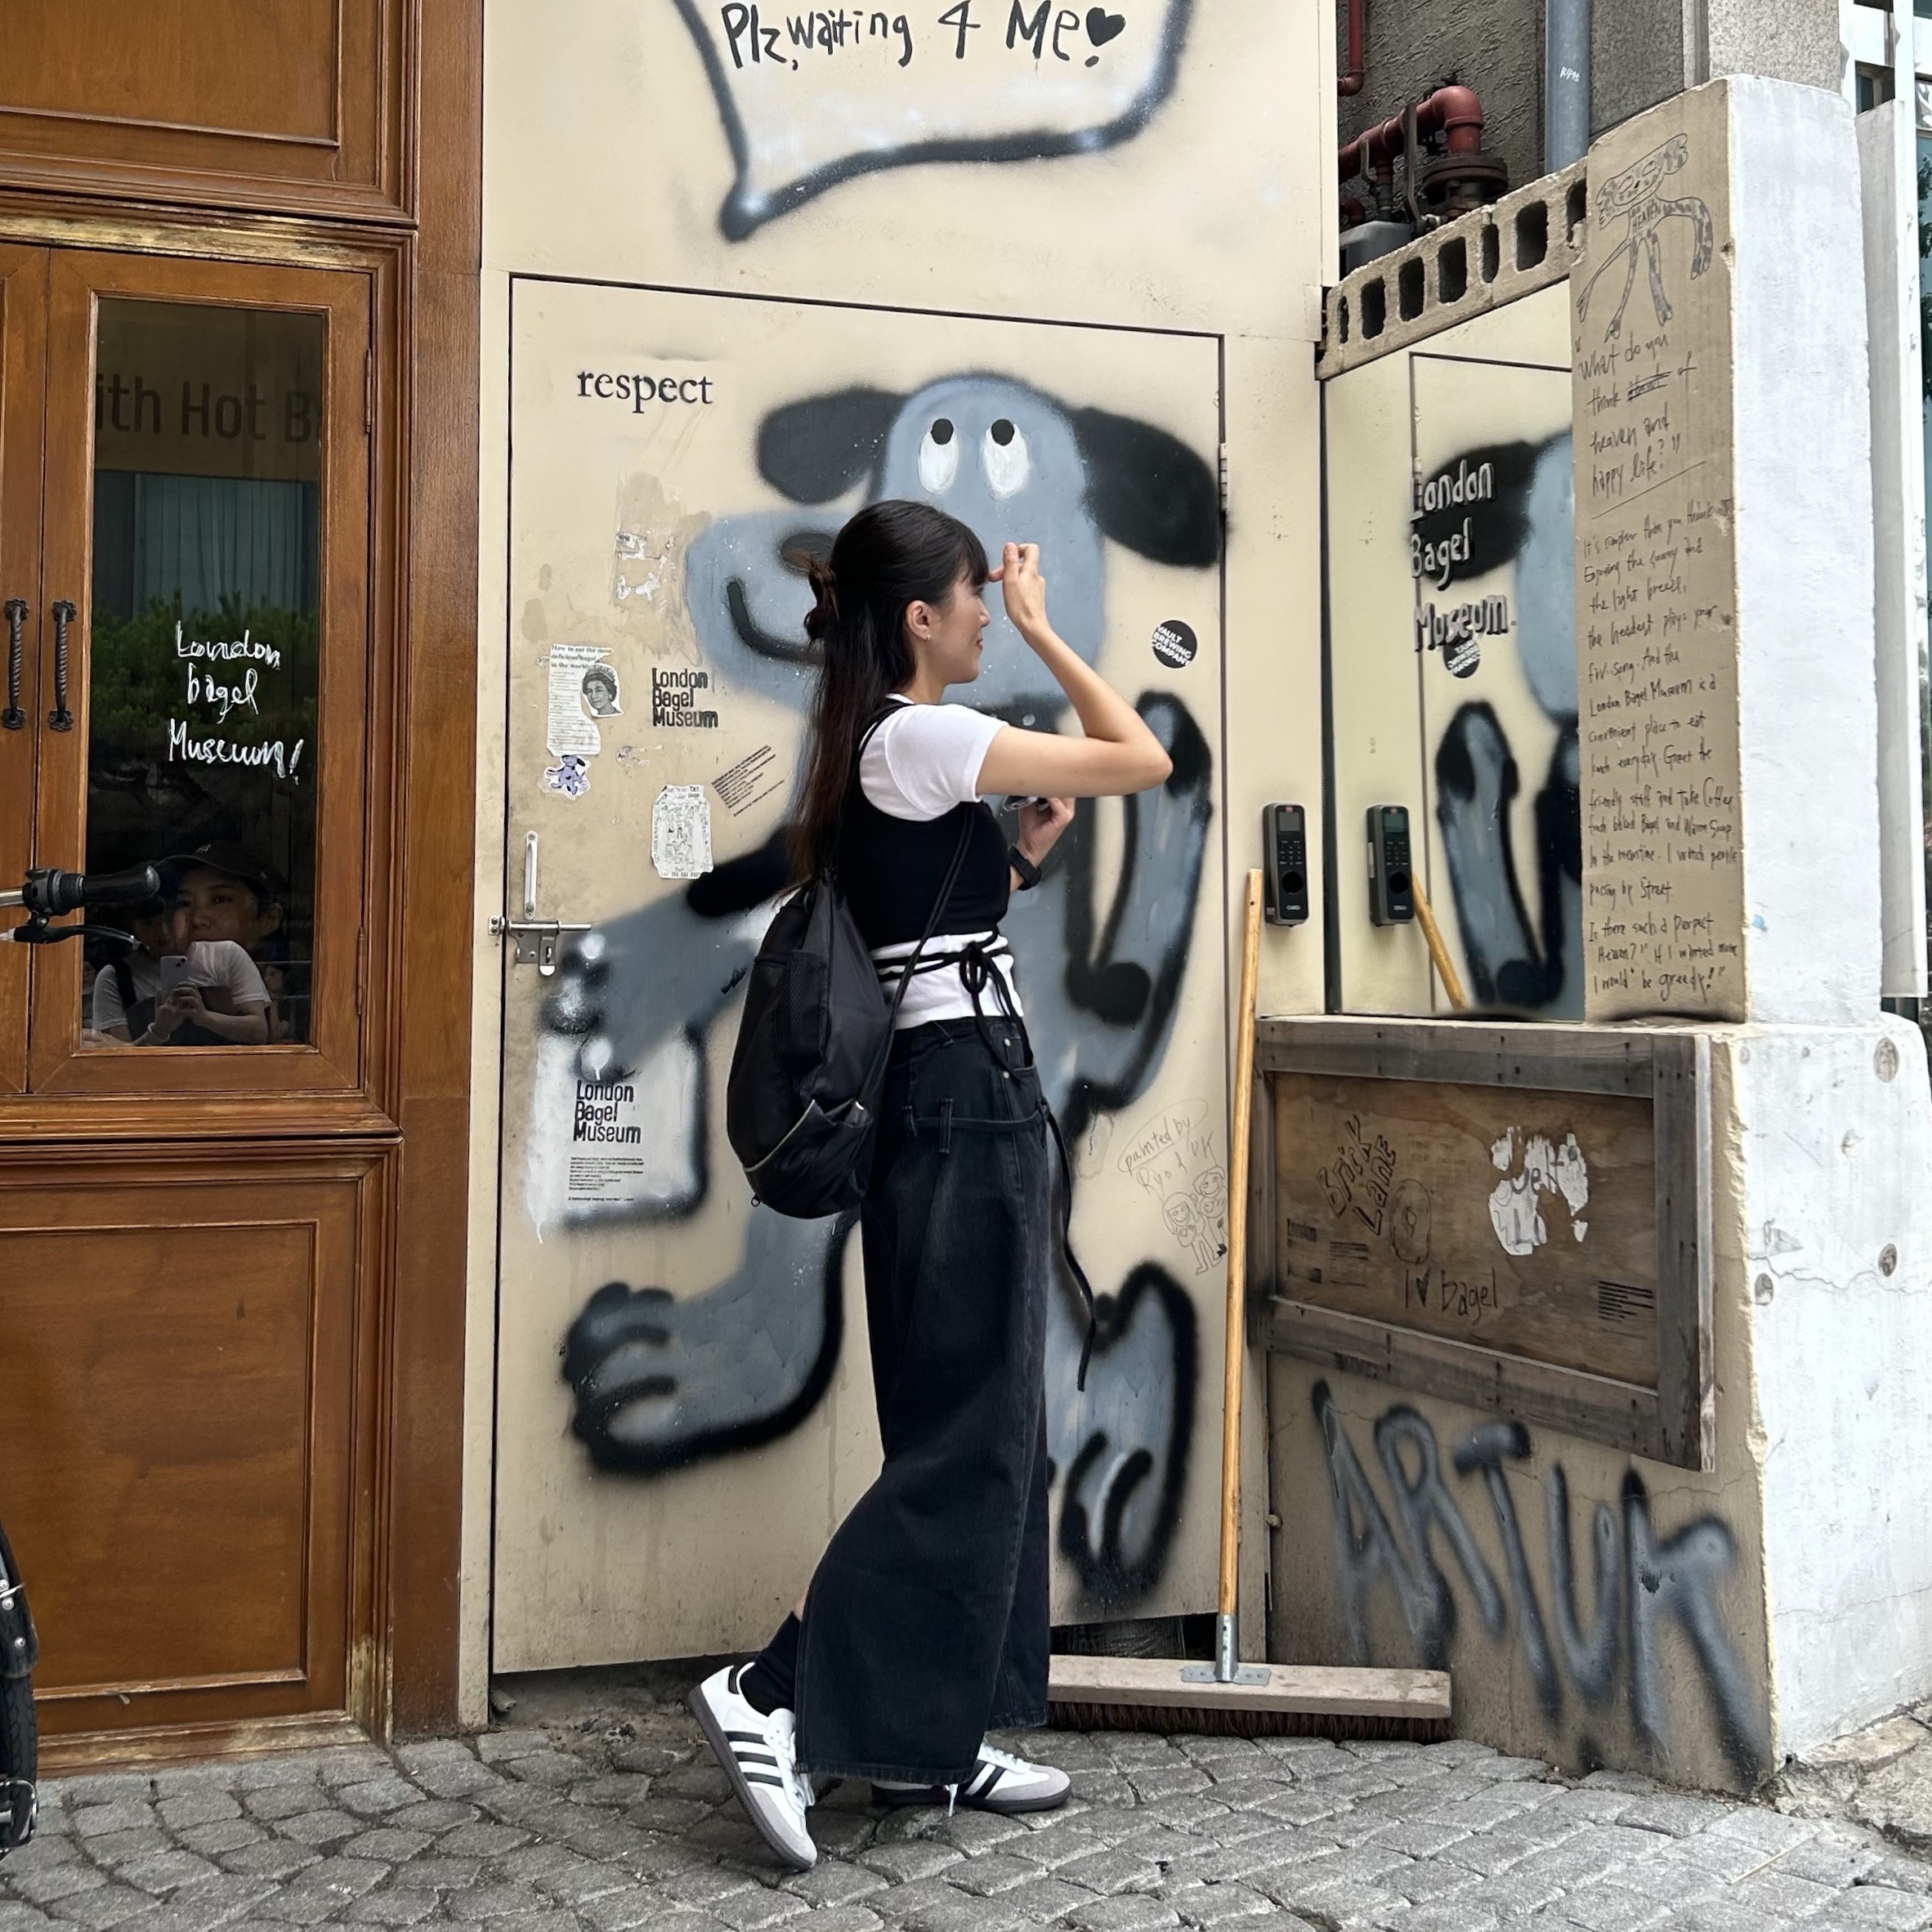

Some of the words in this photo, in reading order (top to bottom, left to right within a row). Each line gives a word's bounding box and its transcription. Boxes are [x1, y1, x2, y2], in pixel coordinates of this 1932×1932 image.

[937, 0, 981, 59] 4
[1625, 330, 1641, 362] do
[1645, 333, 1669, 360] you
[576, 369, 714, 414] respect
[180, 381, 266, 441] Hot
[284, 390, 322, 443] B
[1590, 426, 1637, 454] heaven
[1644, 401, 1670, 437] and
[1411, 458, 1496, 523] London
[1593, 463, 1624, 499] happy
[1411, 516, 1474, 591] Bagel
[1626, 549, 1644, 571] the
[1589, 592, 1608, 614] the
[175, 619, 281, 670] London
[1153, 631, 1192, 659] BREWING
[1157, 626, 1183, 644] VAULT
[1588, 624, 1603, 651] the
[1152, 638, 1192, 666] COMPANY
[651, 667, 708, 688] London
[652, 686, 694, 711] Bagel
[1590, 696, 1621, 718] London
[653, 707, 718, 728] Museum
[1687, 710, 1706, 729] eat
[1666, 843, 1672, 864] I
[1632, 911, 1657, 936] such
[1594, 975, 1599, 995] I
[575, 1079, 634, 1102] London
[575, 1100, 619, 1126] Bagel
[573, 1120, 642, 1144] Museum
[1405, 1269, 1410, 1309] I
[1441, 1267, 1498, 1326] bagel
